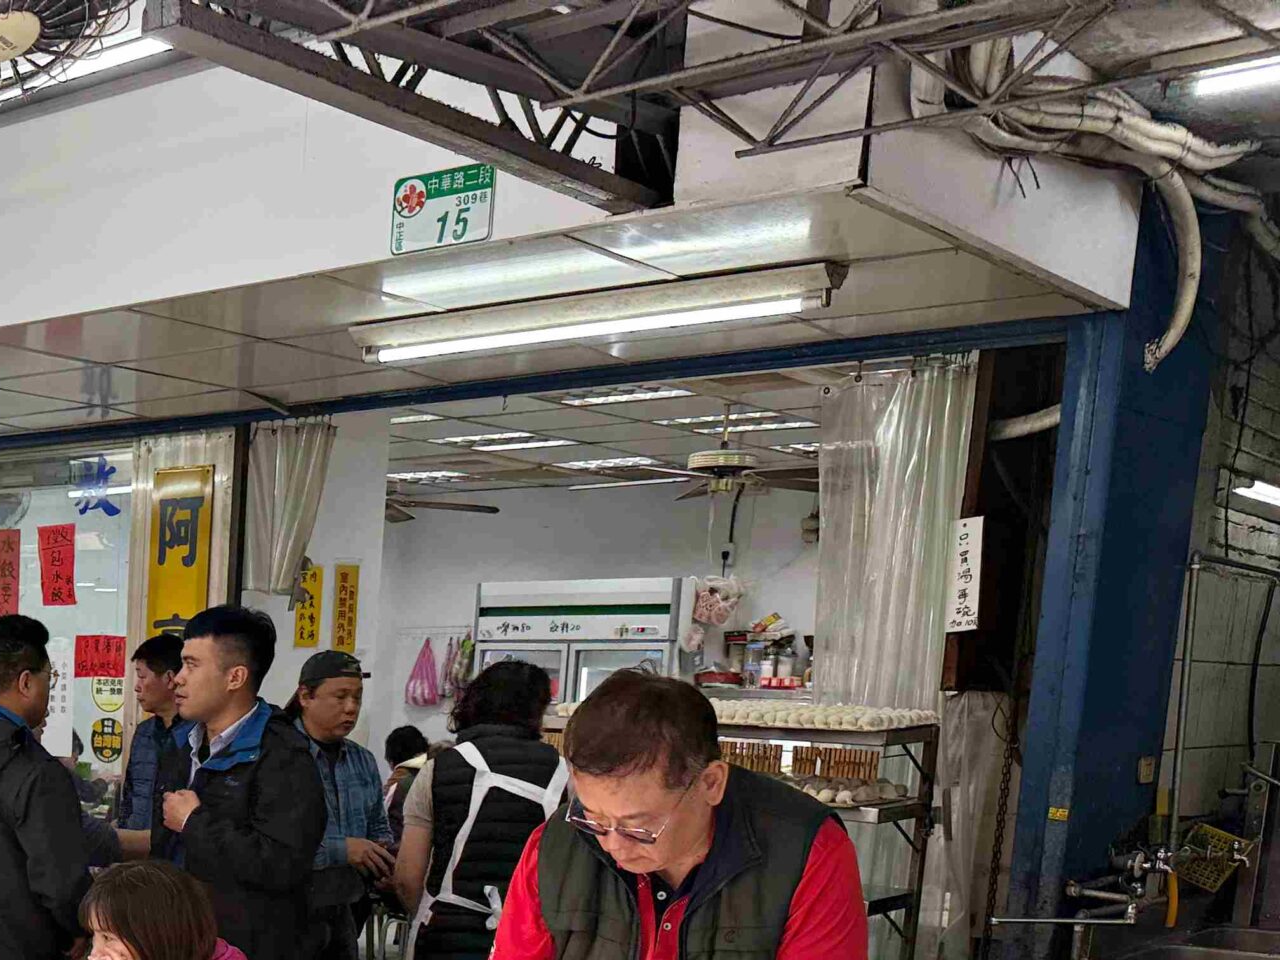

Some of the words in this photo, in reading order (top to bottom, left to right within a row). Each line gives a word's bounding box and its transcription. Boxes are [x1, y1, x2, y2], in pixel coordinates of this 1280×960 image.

[427, 164, 491, 194] 中華路二段
[436, 206, 471, 244] 15
